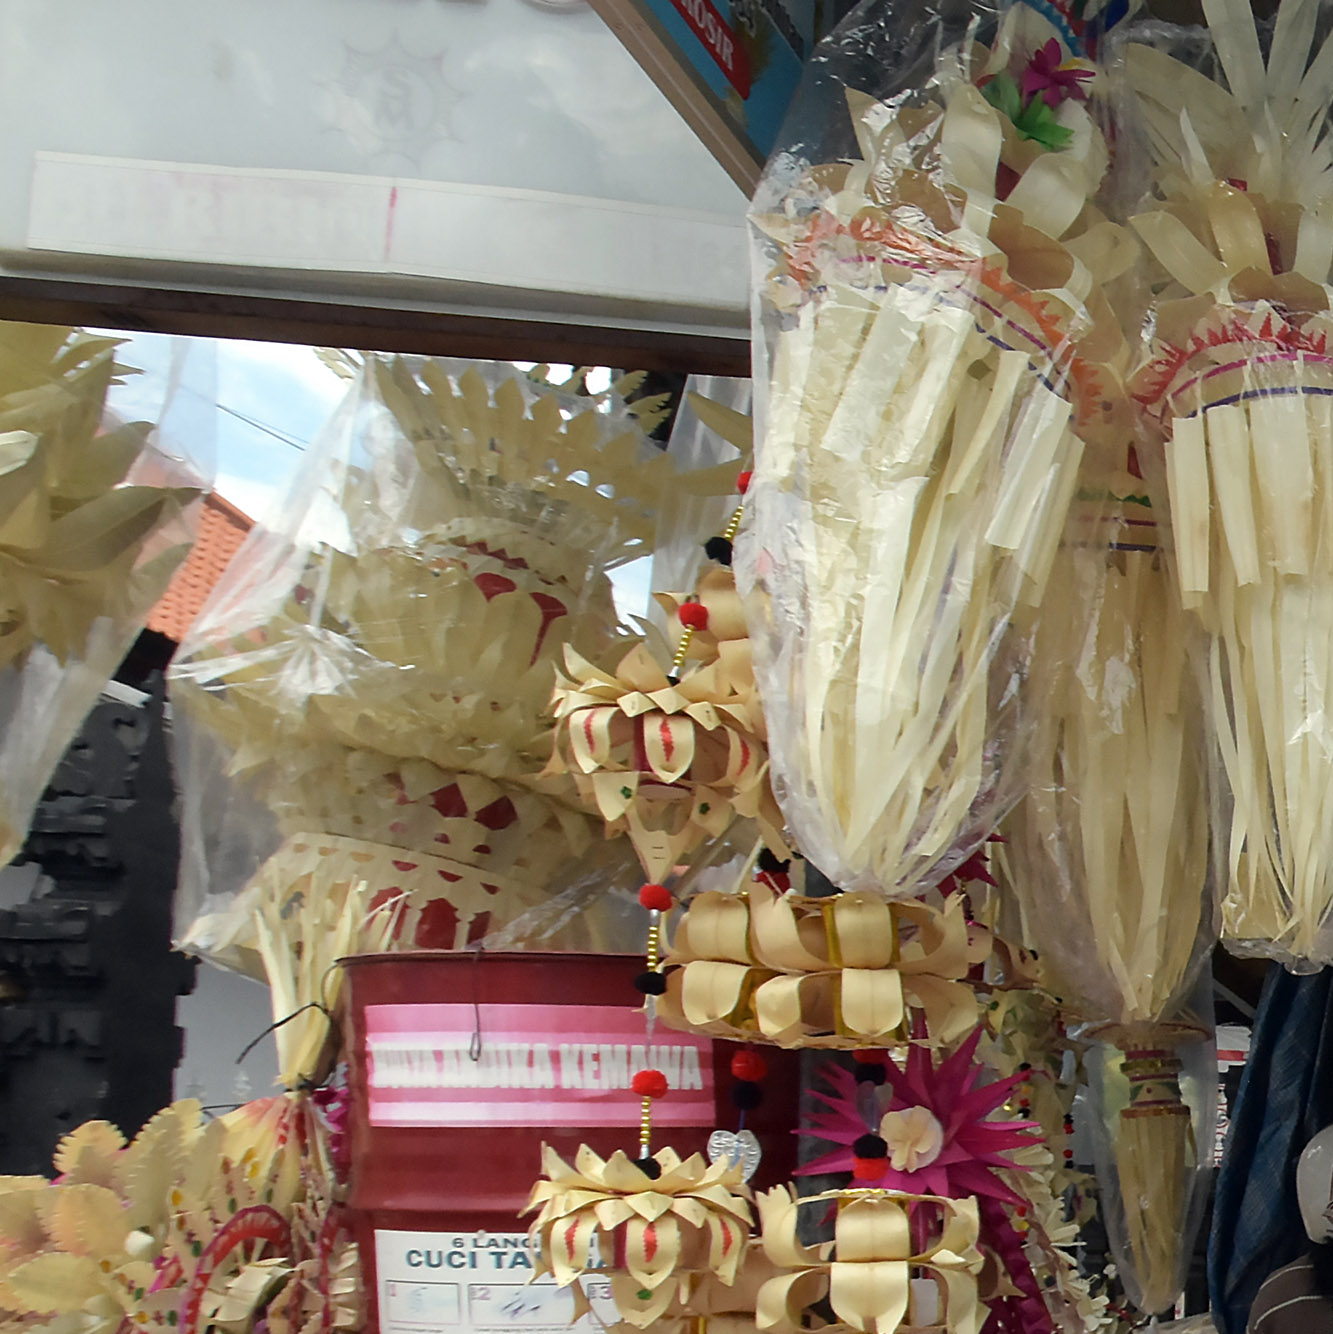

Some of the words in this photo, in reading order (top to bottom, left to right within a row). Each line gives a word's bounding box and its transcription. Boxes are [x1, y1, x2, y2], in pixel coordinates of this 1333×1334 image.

[452, 1237, 464, 1248] 6
[406, 1250, 477, 1269] CUCI
[478, 1287, 491, 1300] 2
